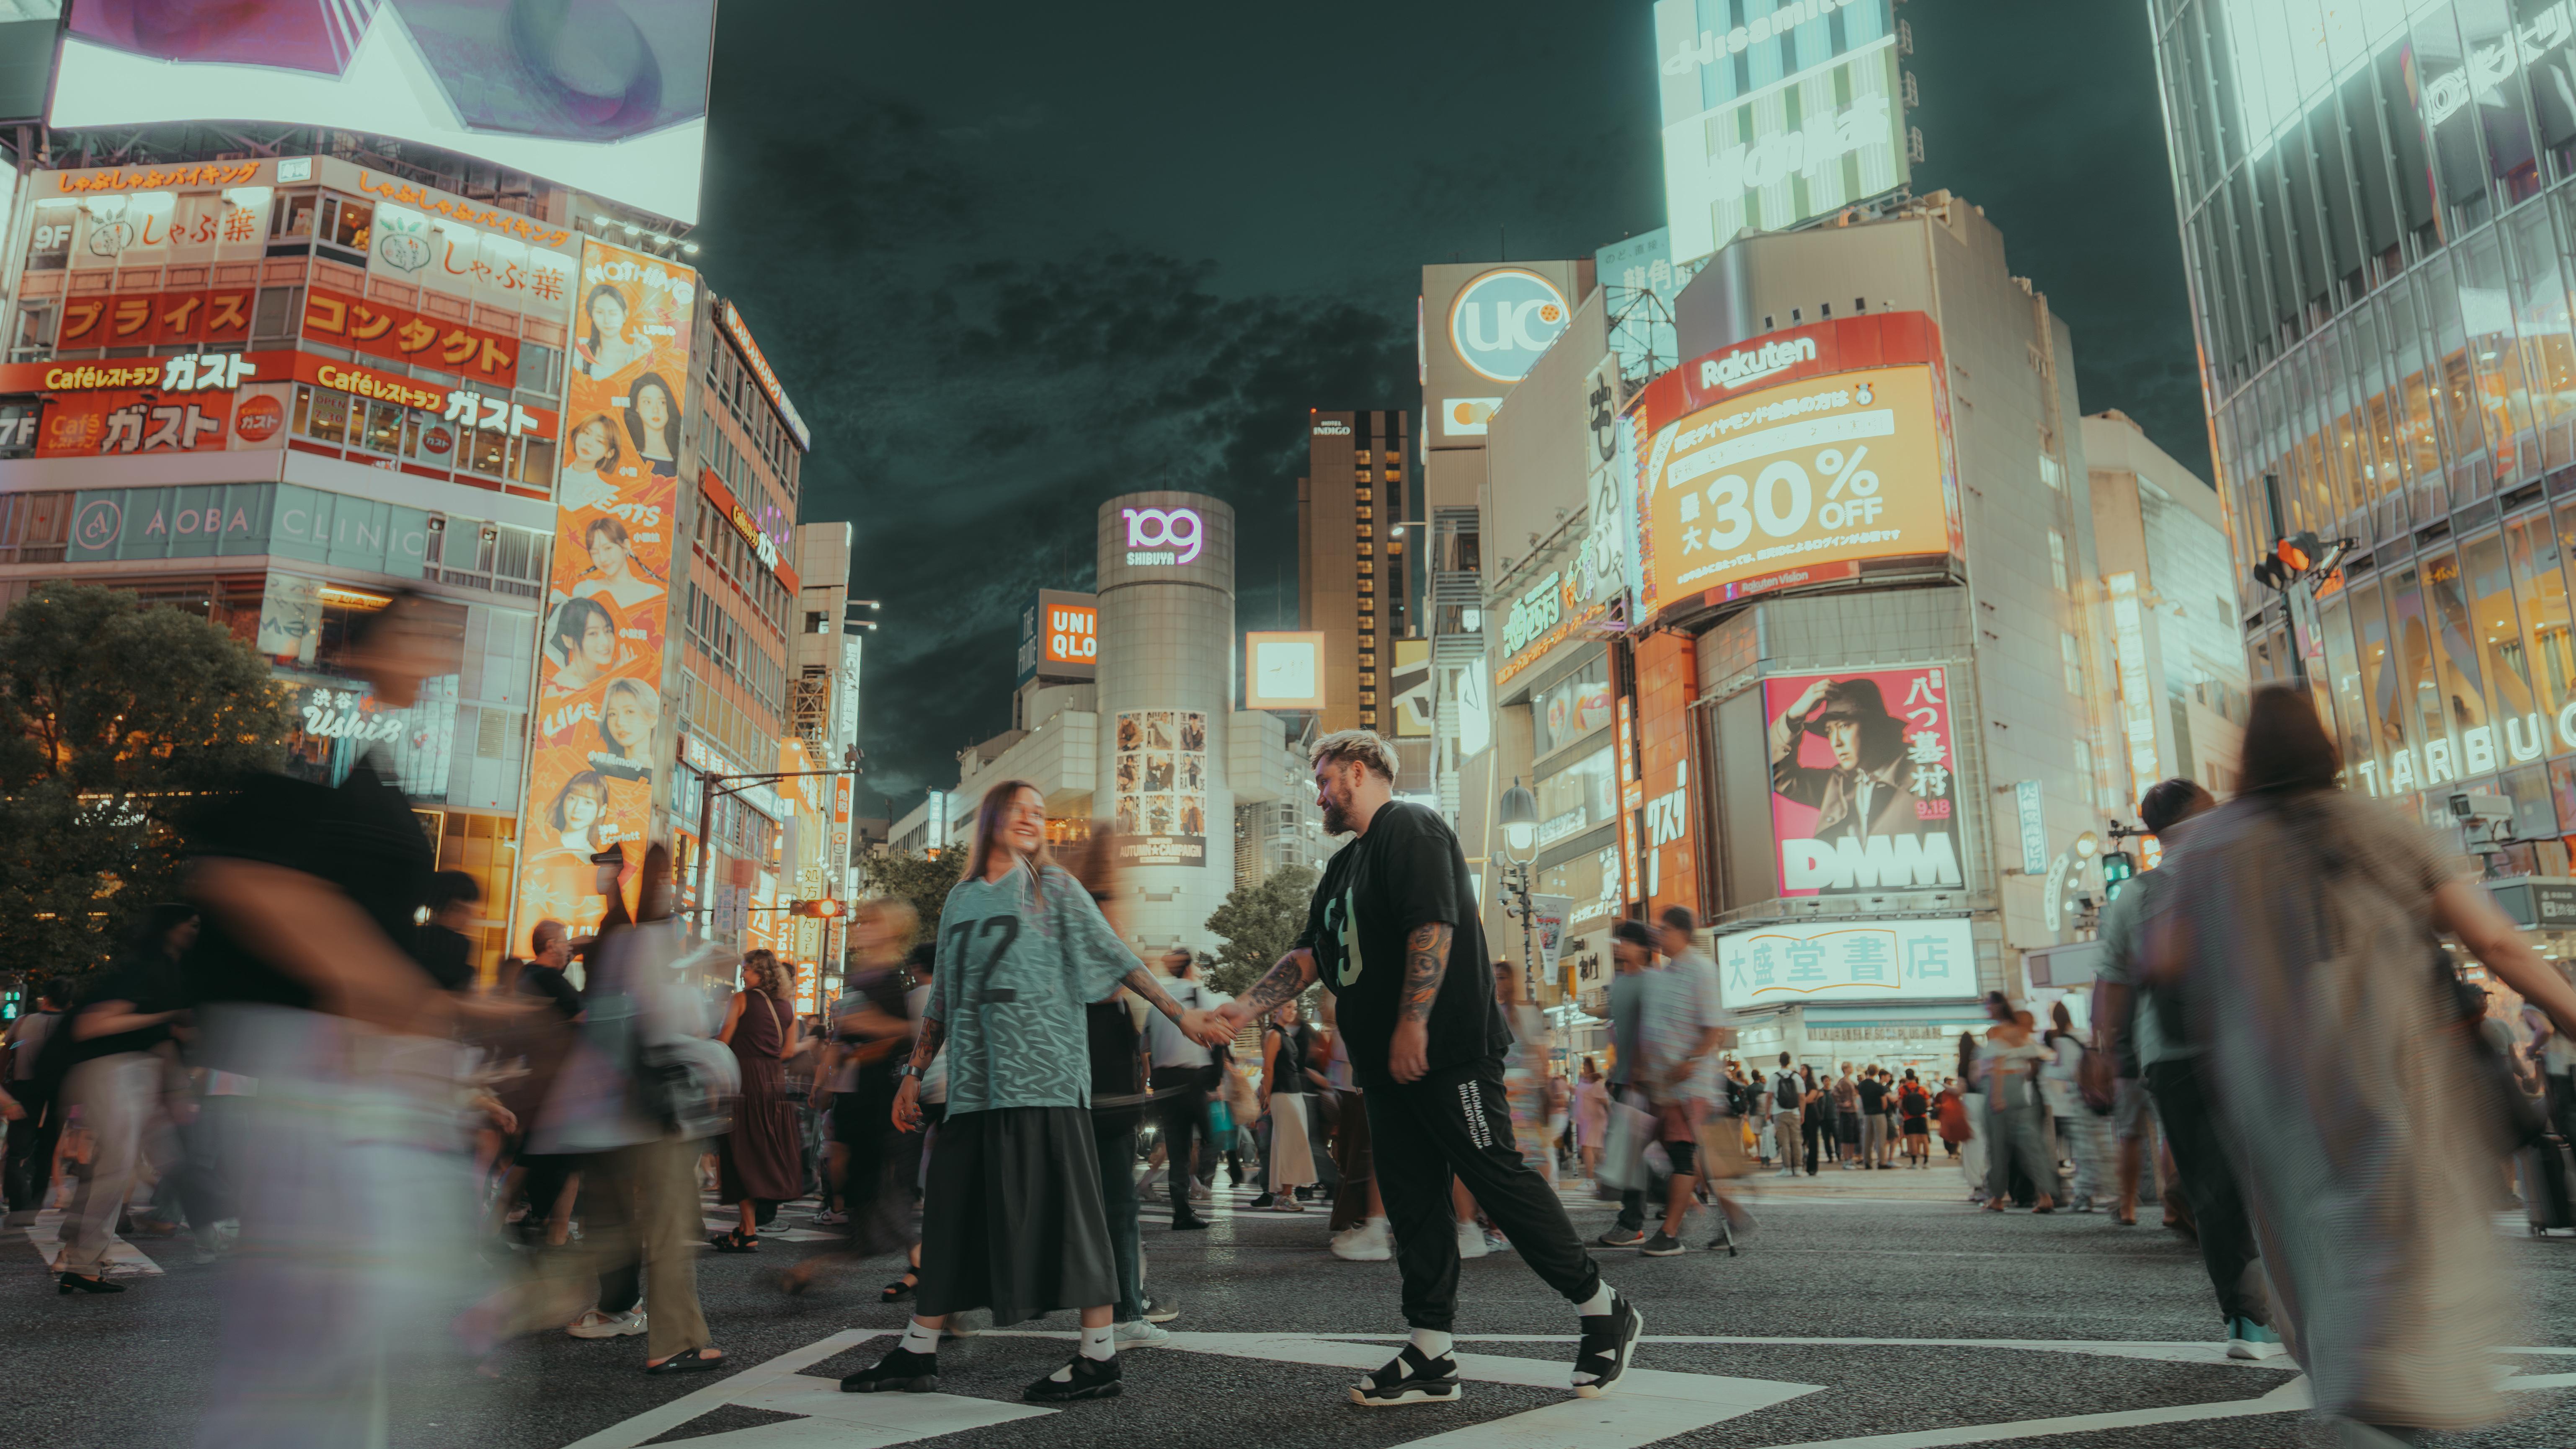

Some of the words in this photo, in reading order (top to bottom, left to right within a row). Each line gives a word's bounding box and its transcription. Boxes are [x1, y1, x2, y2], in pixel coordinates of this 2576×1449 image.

[59, 162, 261, 193] しゃぶしゃぶバイキング
[142, 207, 256, 247] しゃぶ葉
[359, 170, 571, 248] しゃぶしゃぶバイキング
[34, 224, 72, 250] 9F
[444, 240, 565, 301] しゃぶ葉
[586, 261, 694, 305] NOTHING
[65, 294, 249, 339] プライス
[306, 294, 514, 374] コンタクト
[162, 353, 256, 391] ガスト
[1701, 337, 1816, 390] Rakuten
[0, 417, 36, 445] 7F
[101, 404, 220, 454] ガスト
[240, 415, 278, 429] ガスト
[444, 390, 539, 436] ガスト
[1313, 426, 1351, 436] INDIGO
[145, 507, 248, 535] AOBA
[282, 509, 424, 556] CLINIC
[1818, 497, 1883, 530] OFF
[1122, 508, 1202, 564] 109
[1127, 551, 1175, 566] SHIBUYA
[1742, 575, 1778, 593] Rakuten
[1780, 571, 1809, 585] Vision
[1053, 611, 1093, 635] UNI
[1053, 634, 1097, 658] QLO
[313, 688, 353, 710] 渋谷
[543, 702, 599, 737] LIVE
[1903, 677, 1949, 797] 八つ墓村
[774, 796, 784, 822] 4F
[1915, 799, 1951, 815] 9.18
[1781, 831, 1962, 891] DMM
[803, 868, 819, 952] 処方ん3F
[948, 914, 1019, 1004] 72
[1728, 934, 1950, 991] 大盛堂書店
[1467, 1079, 1493, 1147] WHOMADETHIS
